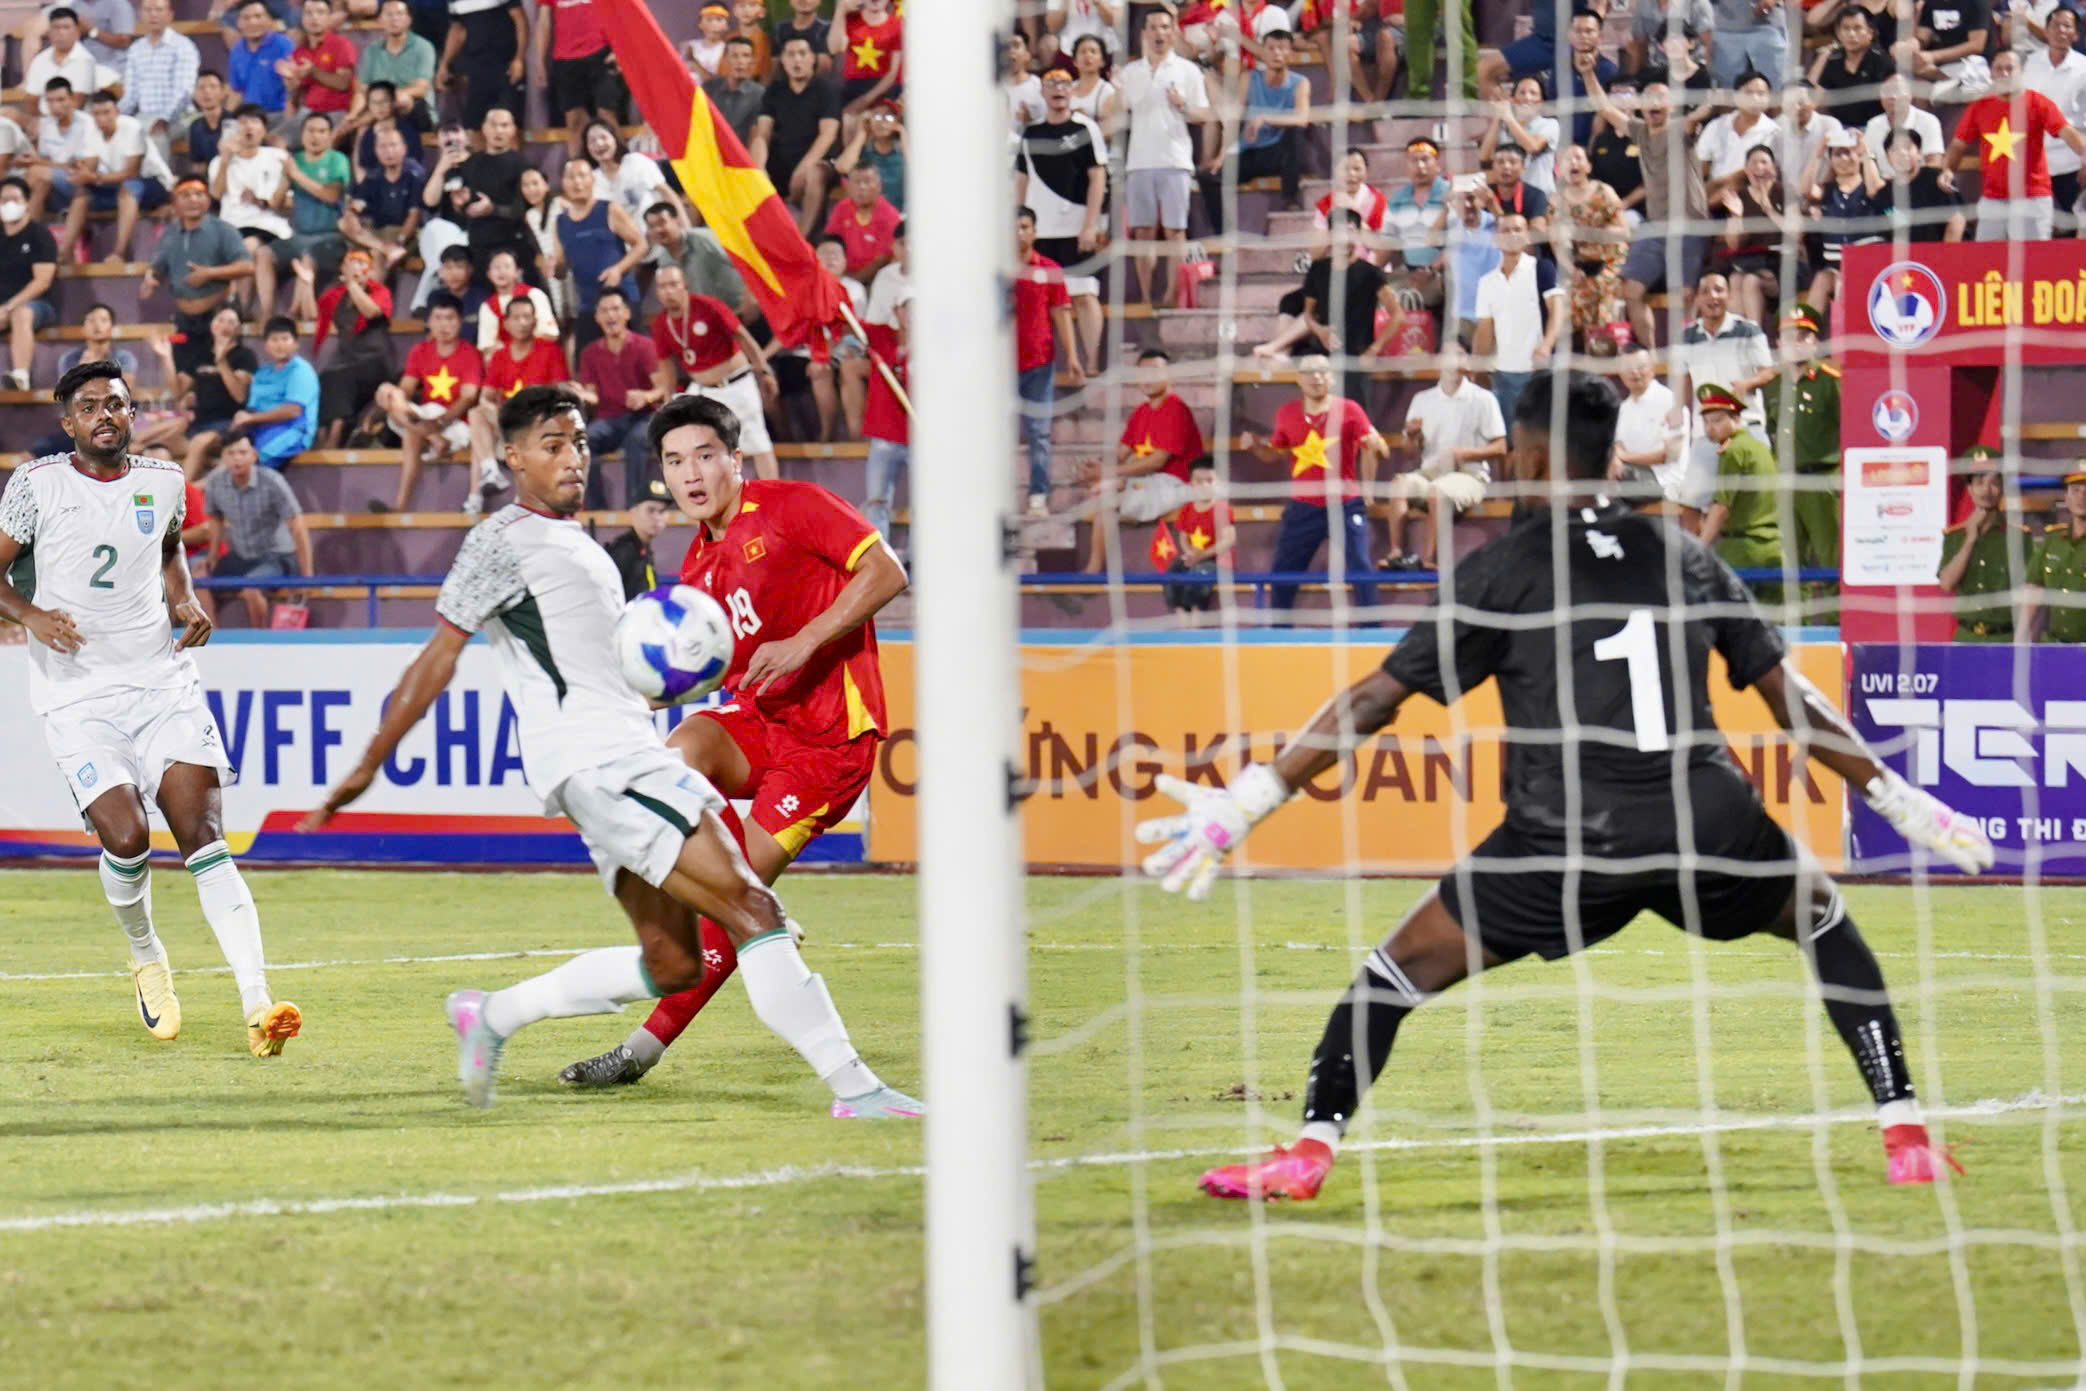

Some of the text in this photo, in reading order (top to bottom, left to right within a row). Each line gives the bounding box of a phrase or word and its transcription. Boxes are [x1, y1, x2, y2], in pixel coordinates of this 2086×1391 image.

[1958, 270, 2023, 326] LIÊN
[90, 544, 119, 589] 2
[725, 588, 762, 640] 19
[1594, 609, 1669, 752] 1
[1862, 674, 1939, 693] UVI 2.07
[2017, 818, 2062, 841] THI
